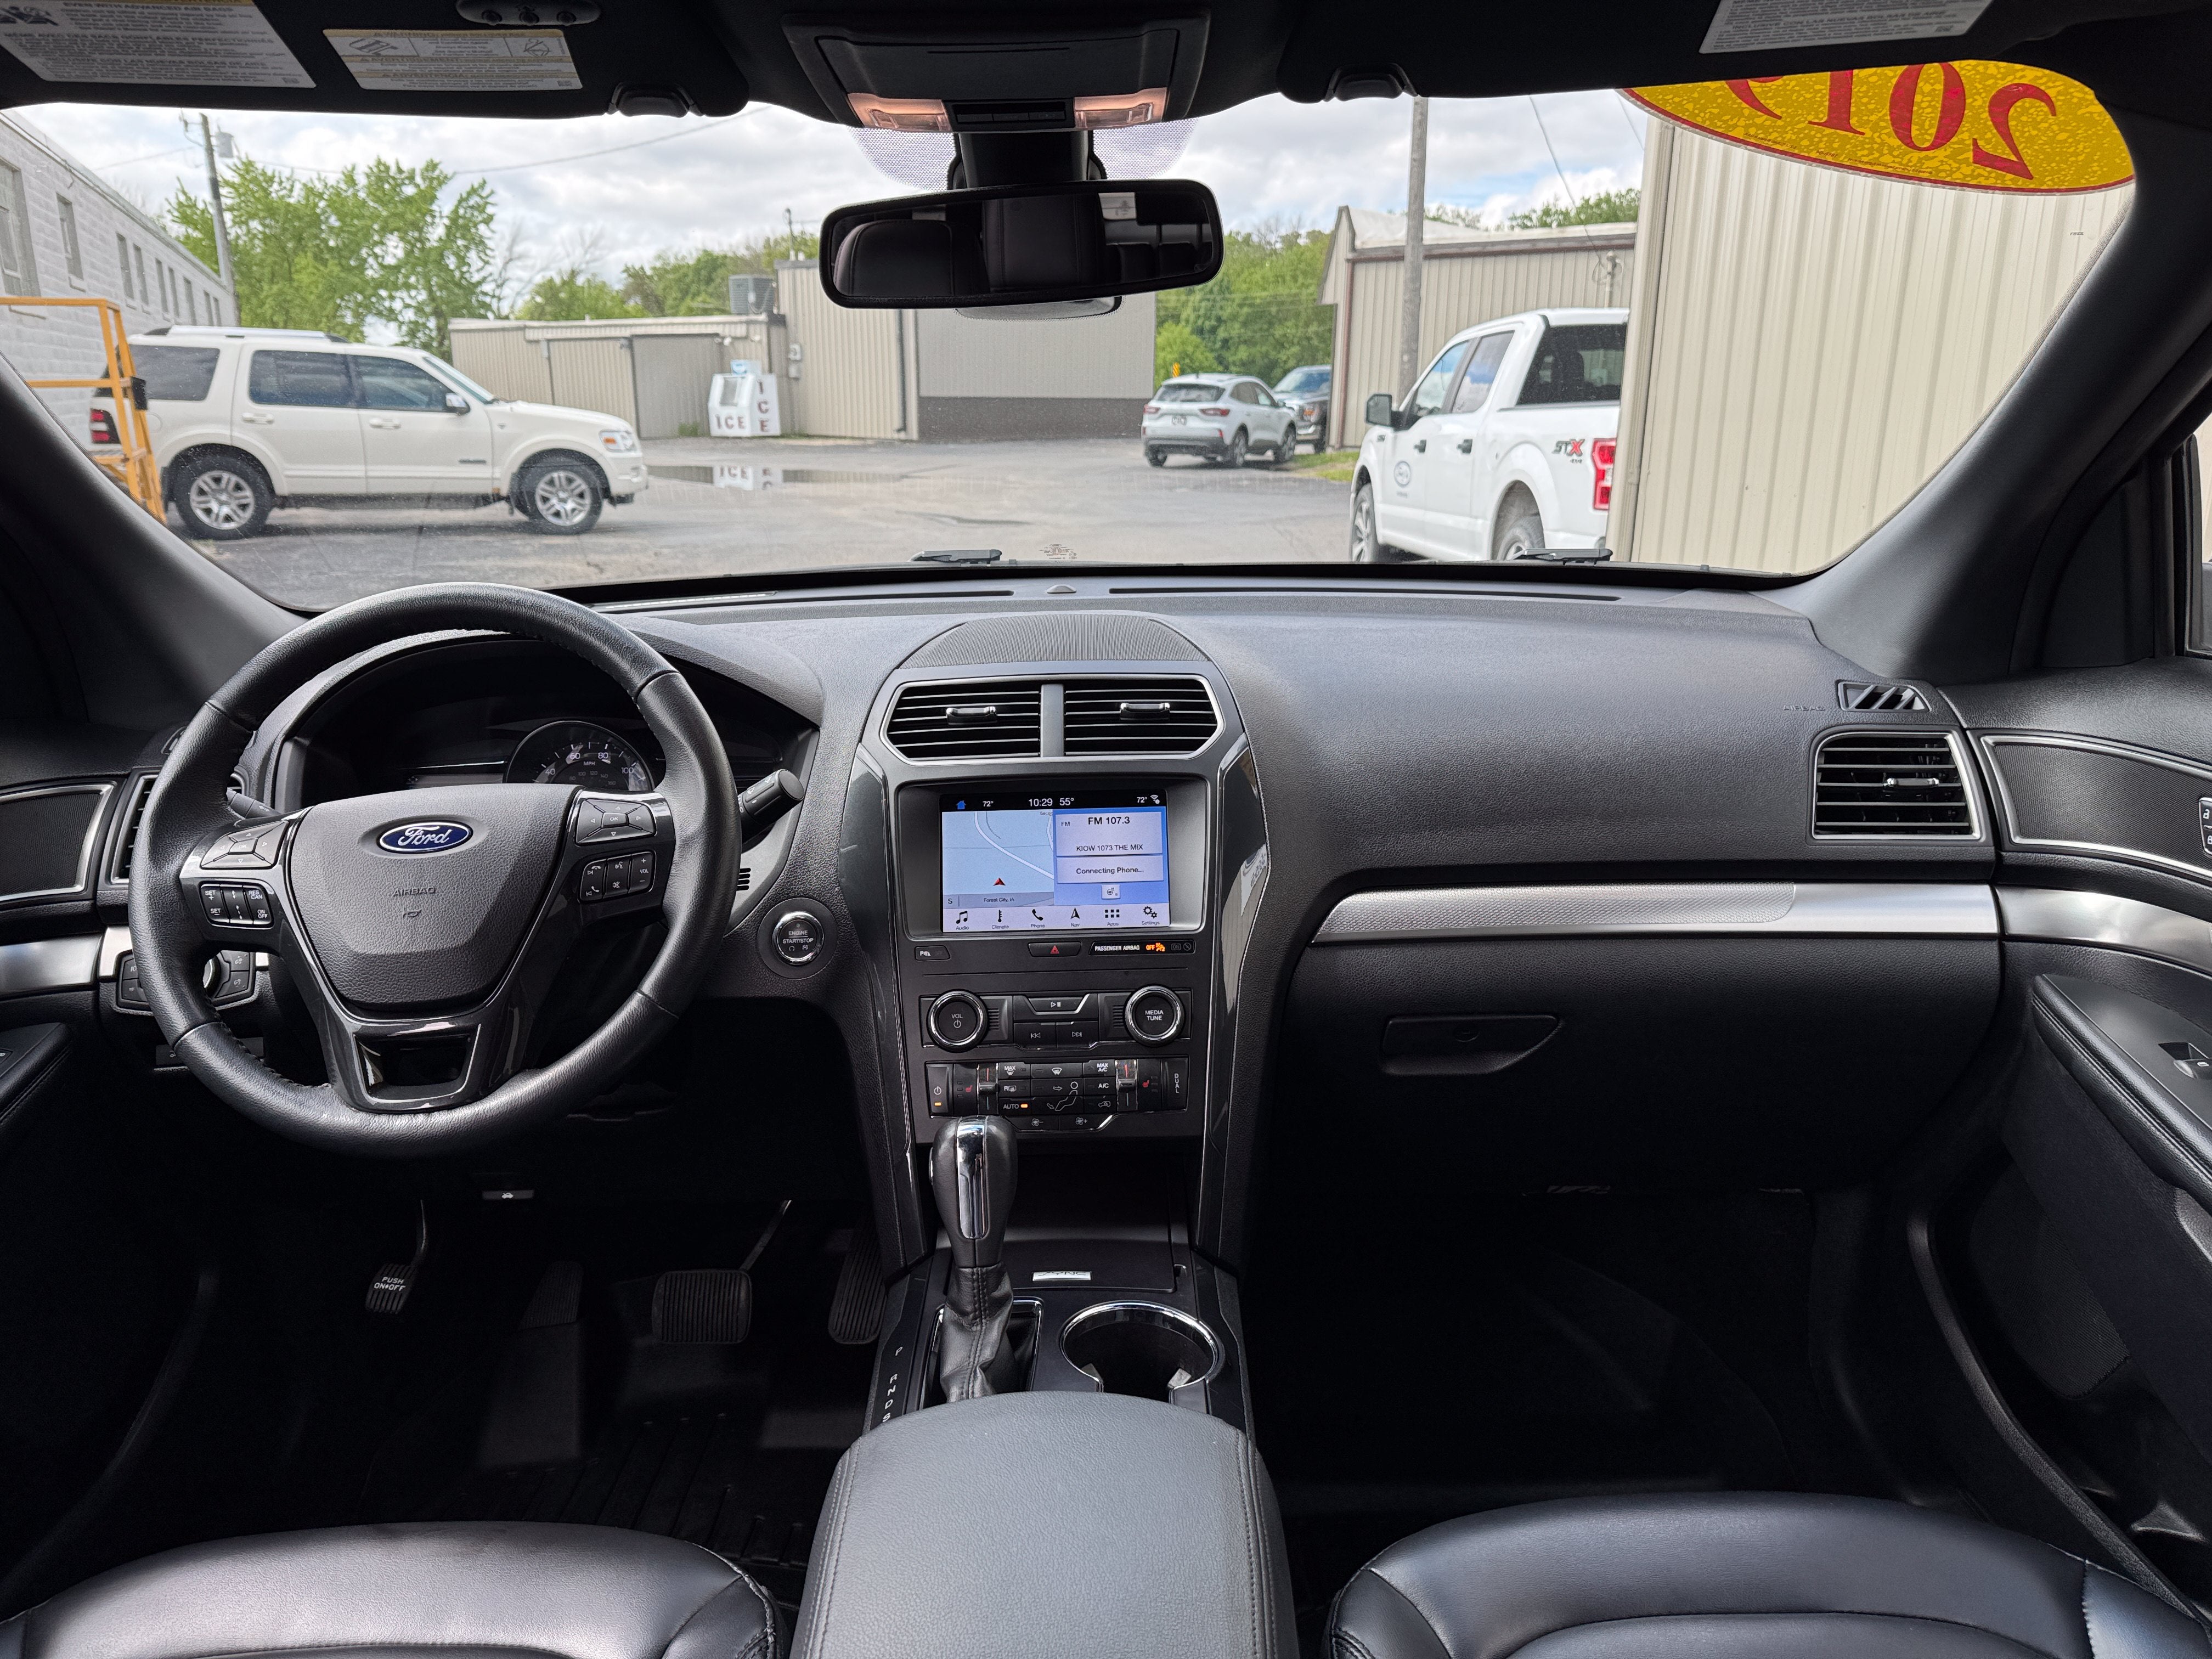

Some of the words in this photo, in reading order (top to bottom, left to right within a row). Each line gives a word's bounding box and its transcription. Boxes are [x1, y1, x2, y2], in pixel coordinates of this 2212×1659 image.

[757, 379, 769, 432] ICE
[715, 414, 745, 430] ICE
[1551, 438, 1585, 457] STX
[1028, 798, 1053, 807] 10:29
[1059, 798, 1074, 806] 55°
[397, 826, 452, 846] Ford
[393, 887, 436, 897] AIRBAG
[381, 1276, 405, 1284] PUSH
[895, 1346, 904, 1356] P
[887, 1385, 896, 1396] N
[884, 1399, 893, 1409] D
[882, 1412, 891, 1423] S
